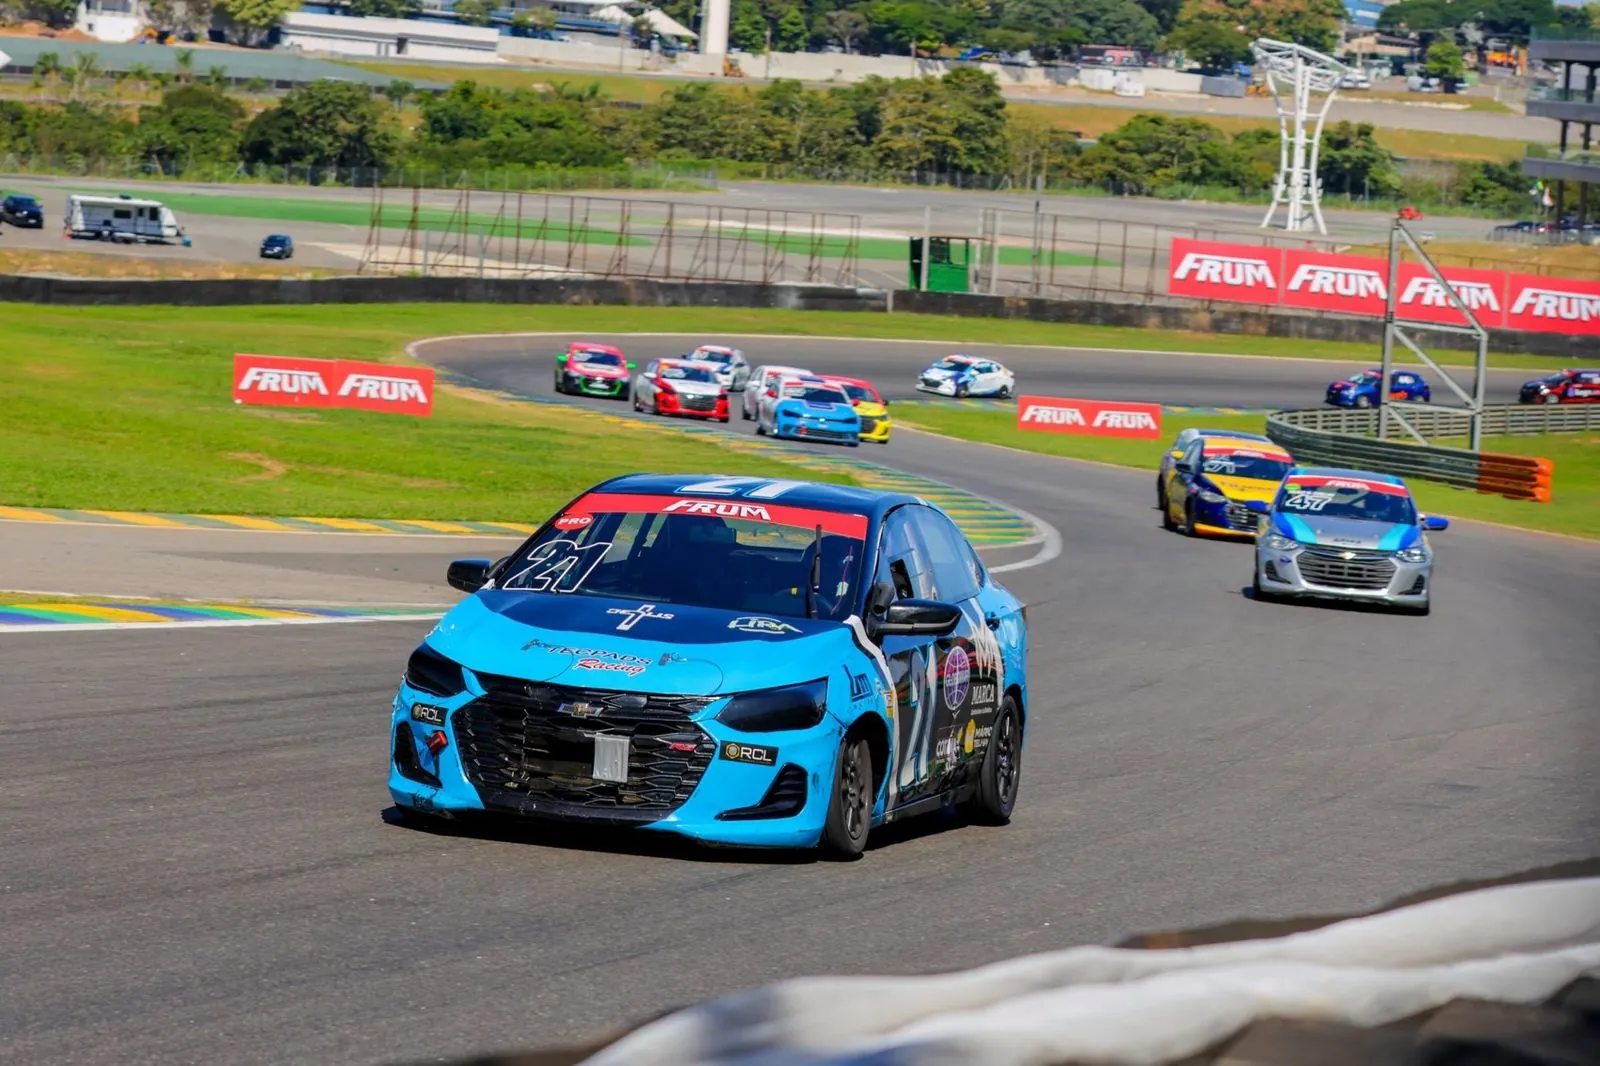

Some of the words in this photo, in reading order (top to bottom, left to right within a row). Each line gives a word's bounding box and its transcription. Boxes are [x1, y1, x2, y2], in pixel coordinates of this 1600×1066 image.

[1173, 252, 1277, 289] FRUM
[1287, 264, 1388, 300] FRUM
[238, 367, 330, 396] FRUM
[337, 373, 429, 404] FRUM
[1020, 405, 1086, 426] FRUM
[1092, 410, 1158, 430] FRUM
[663, 499, 772, 521] FRUM
[557, 517, 592, 525] PRO
[502, 539, 613, 593] 21
[548, 645, 652, 665] TECPADS
[573, 658, 647, 677] Racing
[971, 684, 995, 705] MARCA
[420, 706, 442, 722] RCL
[740, 746, 772, 762] RCL
